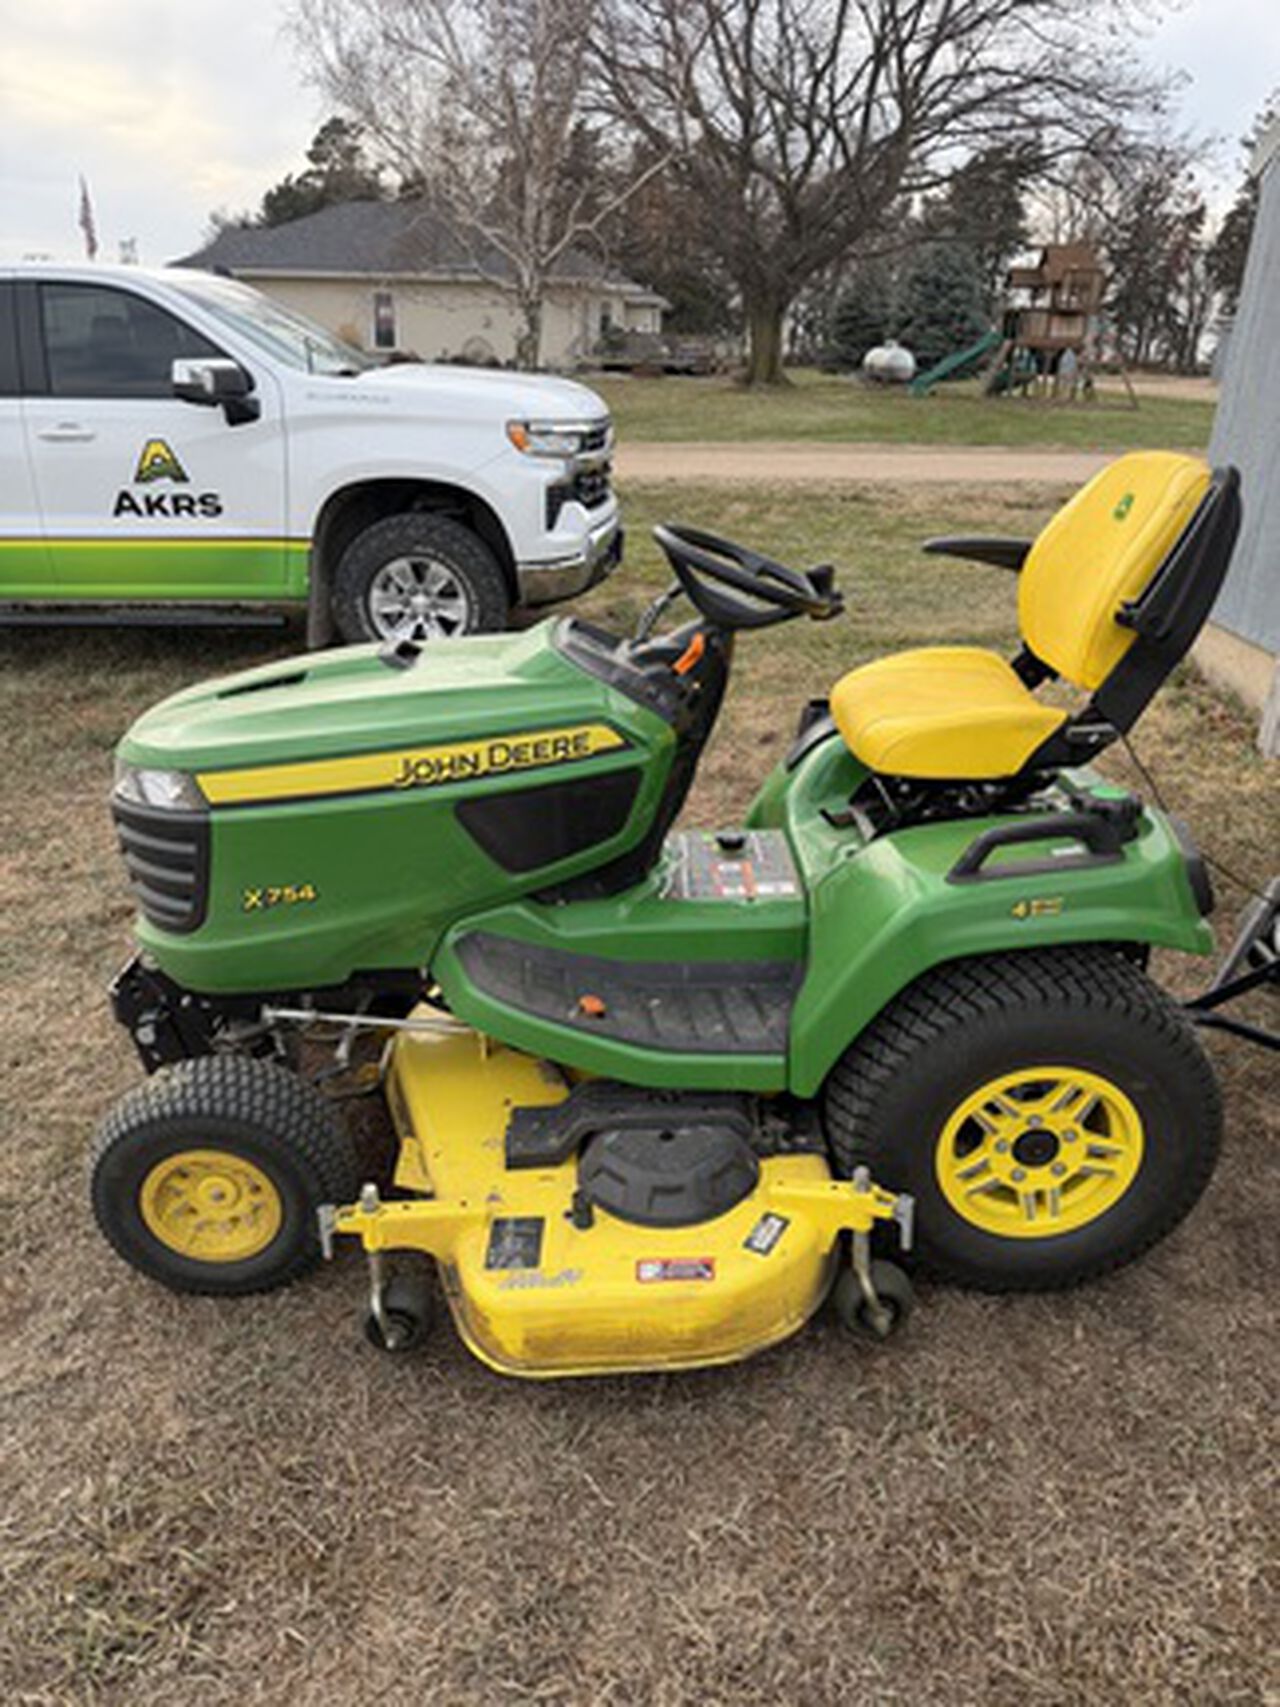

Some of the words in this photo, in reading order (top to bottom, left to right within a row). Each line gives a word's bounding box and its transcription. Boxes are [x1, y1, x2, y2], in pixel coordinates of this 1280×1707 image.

[113, 490, 223, 518] AKRS
[394, 753, 480, 788] JOHN
[487, 731, 591, 769] DEERE
